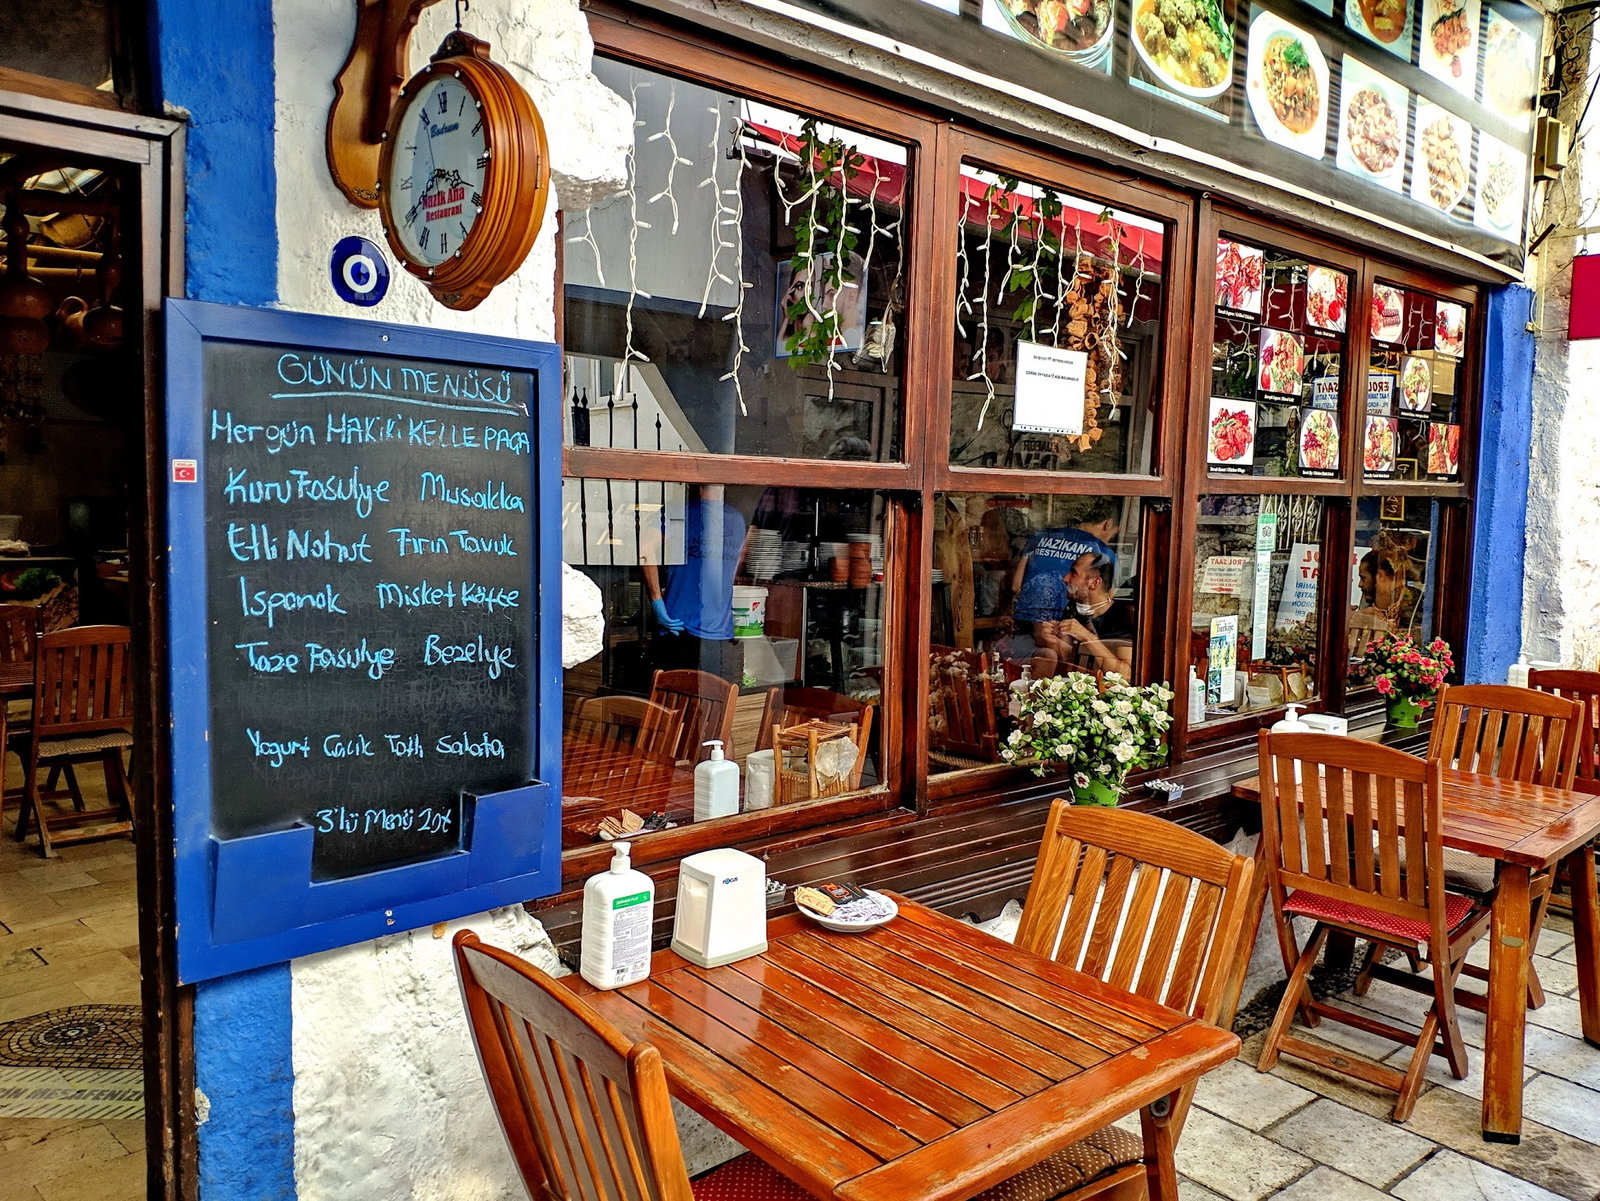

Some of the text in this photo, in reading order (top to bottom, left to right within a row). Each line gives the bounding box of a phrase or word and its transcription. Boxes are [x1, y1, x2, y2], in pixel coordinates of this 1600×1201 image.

[422, 186, 465, 210] Nazik Ana
[425, 204, 463, 223] Restaurant
[277, 352, 512, 404] GÜNÜN MENÜSÜ
[408, 417, 481, 448] KELLE
[223, 464, 391, 520] Kuru Fasulye
[419, 470, 526, 514] Musakka
[226, 522, 374, 564] Etli Nohut
[387, 527, 519, 558] Fırın Tavuk
[1034, 548, 1082, 561] RESTAURA
[239, 575, 349, 629] Ispanak
[375, 579, 520, 614] Misket Köfte
[234, 637, 397, 681] Taze Fasulye
[423, 633, 517, 680] Bezelye
[435, 730, 506, 760] Salata
[363, 807, 415, 836] Menü
